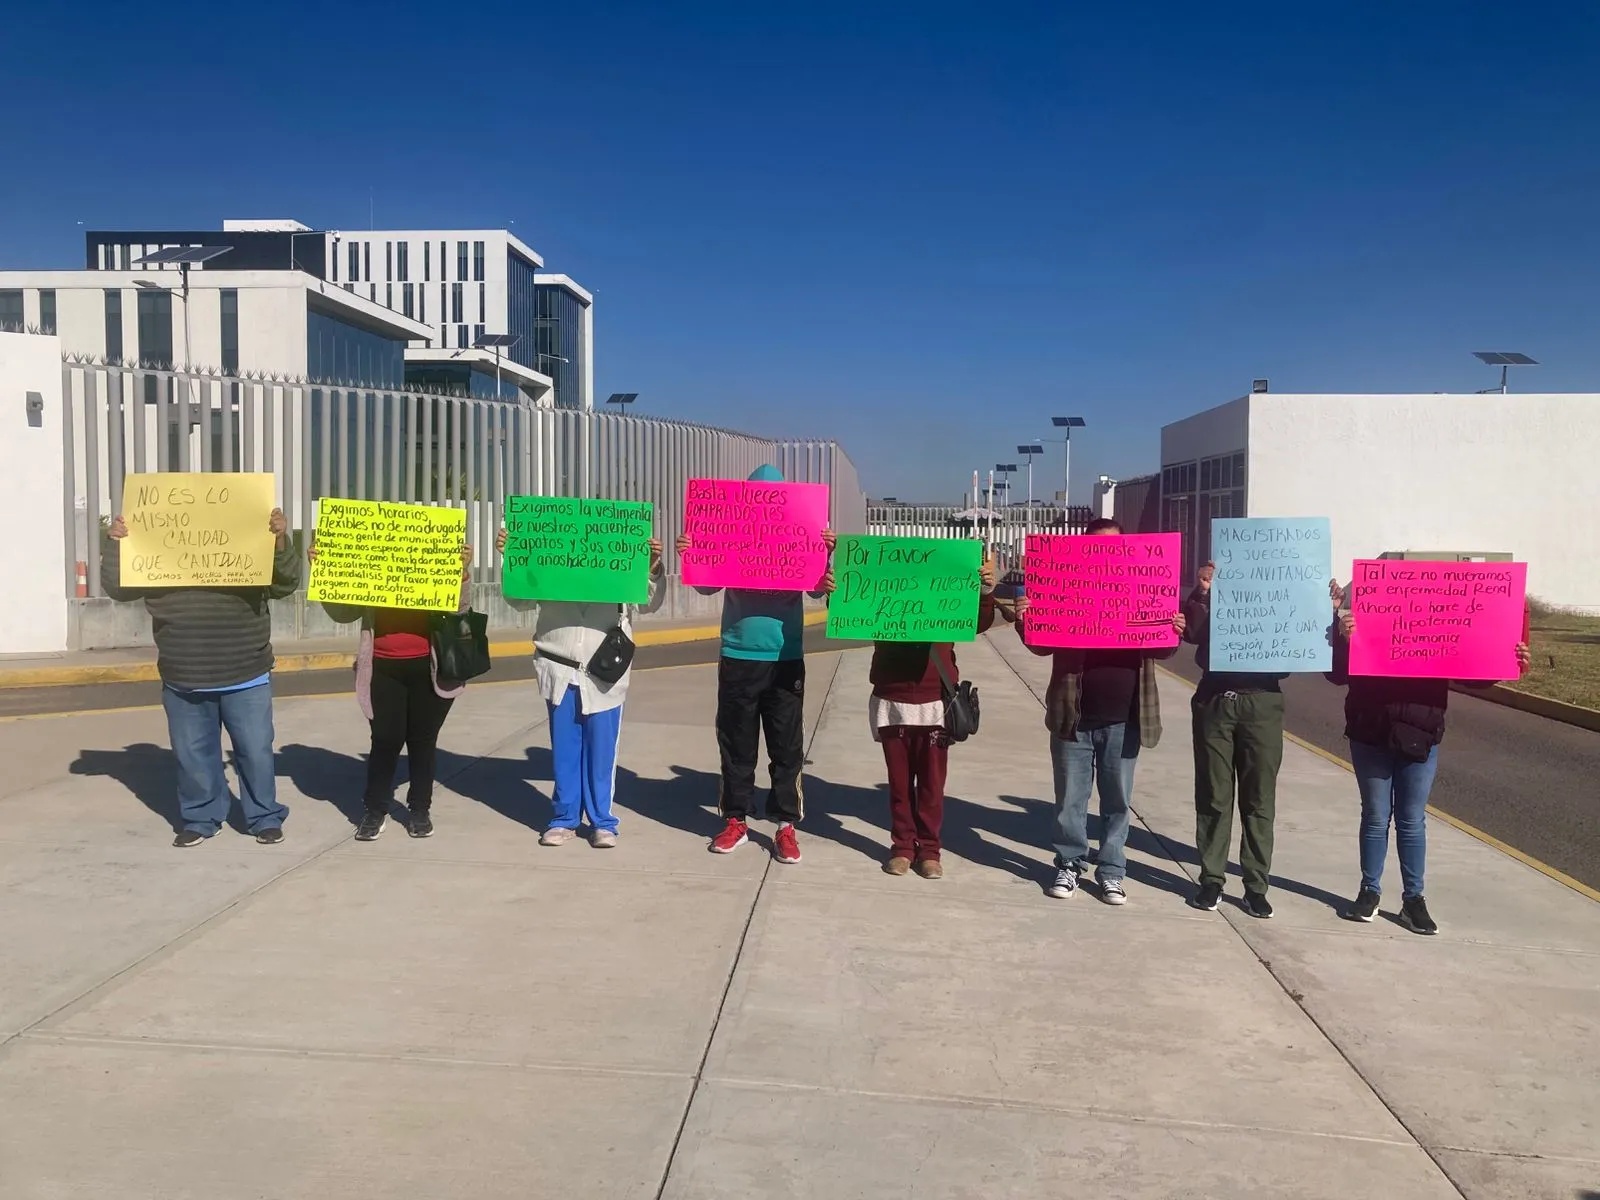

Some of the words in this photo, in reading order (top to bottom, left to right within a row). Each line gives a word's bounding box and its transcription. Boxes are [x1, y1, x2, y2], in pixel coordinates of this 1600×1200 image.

[137, 486, 159, 507] NO
[168, 488, 195, 505] ES
[206, 487, 229, 504] LO
[688, 480, 726, 500] Basta
[378, 503, 428, 521] horarios
[509, 495, 574, 518] Exigimos
[579, 499, 592, 517] la
[595, 502, 652, 522] vestimenta
[685, 501, 757, 522] COMPRADOS
[132, 511, 190, 531] MISMO
[372, 521, 384, 531] no
[387, 519, 400, 532] de
[404, 520, 465, 537] madrugada
[508, 514, 524, 533] de
[527, 517, 579, 534] nuestros
[585, 521, 644, 540] pacientes
[685, 518, 739, 537] llegaron
[741, 521, 755, 537] al
[759, 523, 807, 541] precio
[163, 529, 229, 549] CALIDAD
[356, 531, 382, 542] gente
[385, 532, 396, 542] de
[1219, 527, 1321, 543] MAGISTRADOS
[569, 539, 576, 553] y
[846, 539, 870, 566] Por
[877, 540, 936, 566] Favor
[1027, 535, 1072, 555] IMSS
[1082, 539, 1136, 559] ganaste
[1144, 544, 1164, 558] ya
[132, 555, 163, 572] QUE
[365, 553, 388, 561] como
[508, 555, 528, 572] por
[683, 552, 727, 568] cuerpo
[739, 552, 807, 568] vendidos
[1244, 549, 1300, 561] JUECES
[312, 568, 325, 578] de
[386, 575, 401, 586] por
[396, 563, 427, 574] nuestra
[740, 566, 805, 580] corruptos
[1088, 564, 1102, 576] en
[1104, 560, 1125, 577] tus
[1127, 563, 1173, 579] manos
[1217, 568, 1245, 580] LOS
[1250, 565, 1323, 581] INVITAMOS
[1356, 562, 1386, 582] Tal
[1390, 570, 1417, 581] vez
[1420, 570, 1438, 581] no
[1443, 570, 1512, 582] mueramos
[374, 583, 415, 593] nosotros
[1025, 572, 1058, 588] ahora
[842, 570, 919, 608] Dejanos
[929, 573, 980, 593] nuestra
[1217, 589, 1225, 604] A
[1231, 590, 1262, 604] VIVIR
[1267, 587, 1291, 602] UNA
[1355, 584, 1378, 602] por
[1386, 583, 1467, 598] enfermedad
[1473, 581, 1512, 598] Renal
[395, 591, 443, 608] Presidente
[1049, 592, 1094, 607] nuestra
[1101, 598, 1130, 610] ropa
[1136, 598, 1163, 611] pues
[1357, 601, 1402, 614] Ahora
[1409, 601, 1423, 613] lo
[1465, 598, 1484, 615] de
[875, 597, 926, 623] Ropa
[937, 598, 961, 611] no
[1099, 608, 1121, 621] por
[1215, 606, 1276, 620] ENTRADA
[1289, 605, 1297, 618] Y
[831, 616, 875, 634] quiero
[883, 619, 906, 631] una
[913, 619, 974, 631] neumonia
[1027, 618, 1062, 633] Somos
[1068, 622, 1114, 637] adultos
[1118, 630, 1169, 646] mayores
[1217, 621, 1265, 636] SALIDA
[1274, 620, 1289, 634] DE
[1296, 619, 1319, 633] UNA
[1392, 615, 1472, 633] Hipotermia
[871, 631, 908, 640] ahora
[1272, 638, 1290, 649] DE
[1391, 632, 1460, 646] Neumonia
[1229, 648, 1317, 662] HEMODIALISIS
